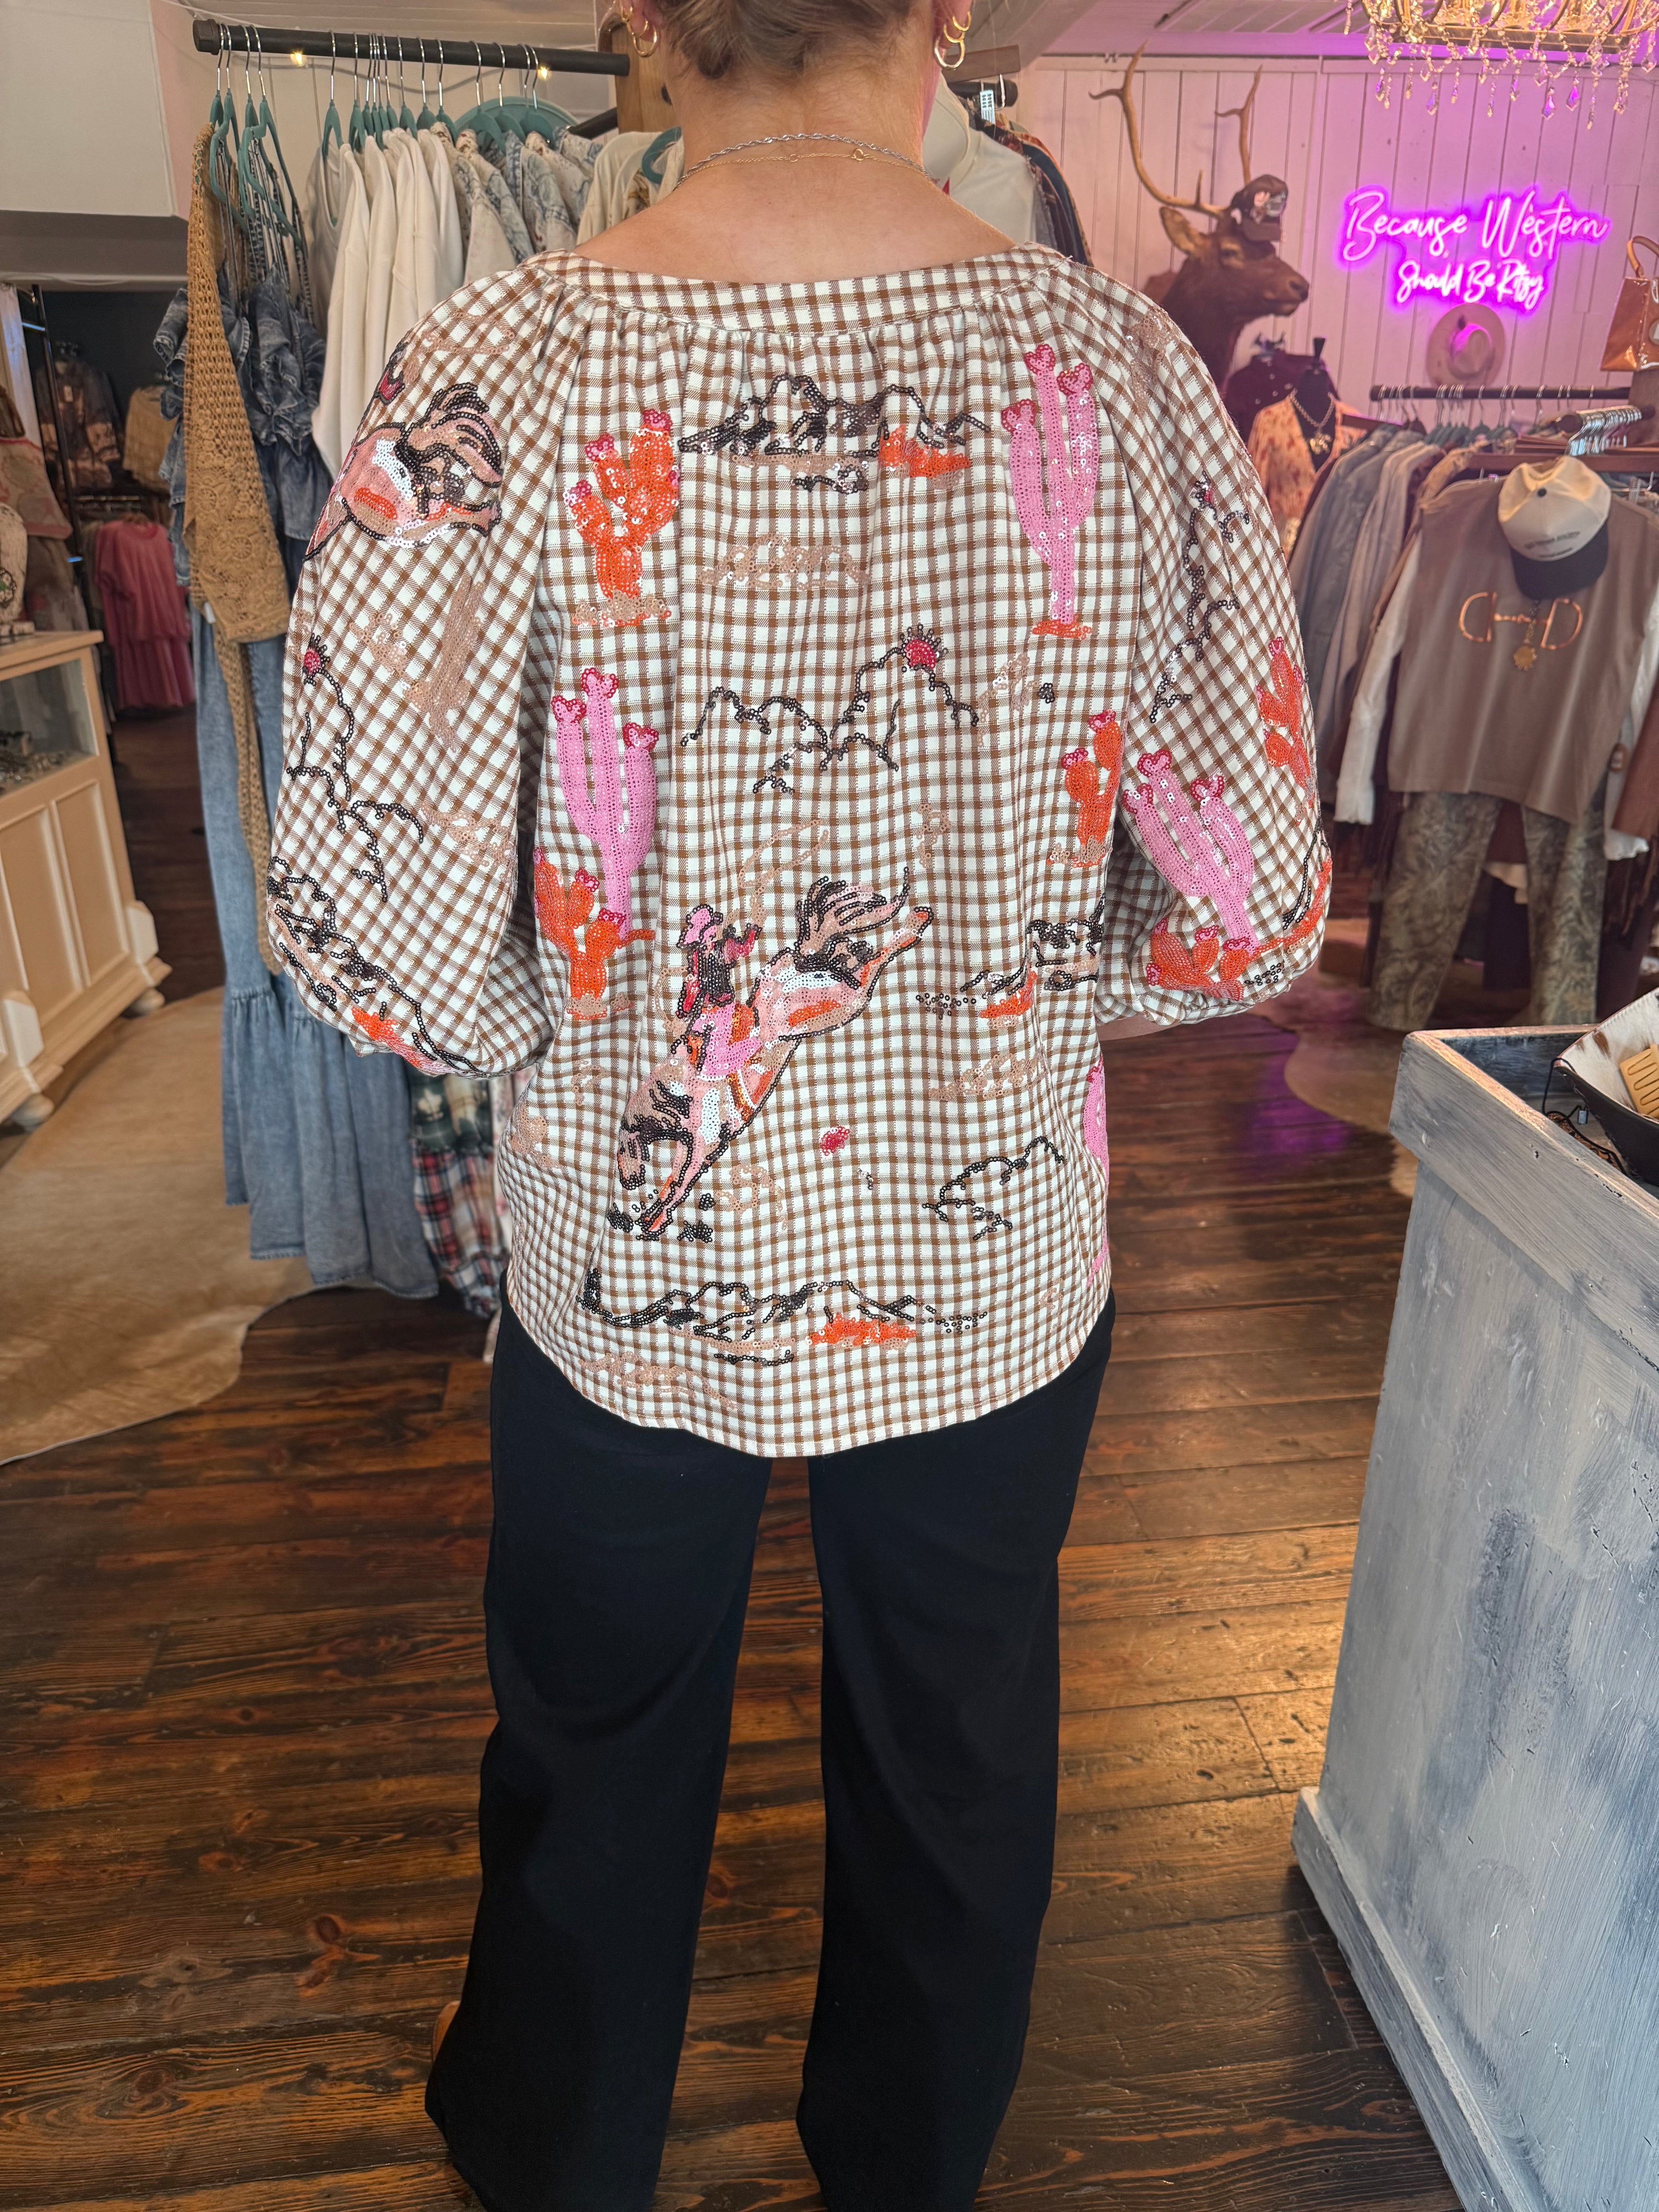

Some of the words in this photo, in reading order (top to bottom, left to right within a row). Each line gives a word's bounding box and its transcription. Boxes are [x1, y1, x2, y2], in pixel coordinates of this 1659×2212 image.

[1342, 189, 1468, 262] Because
[1480, 189, 1608, 260] Western
[1396, 259, 1465, 303] Should
[1463, 259, 1496, 303] Be
